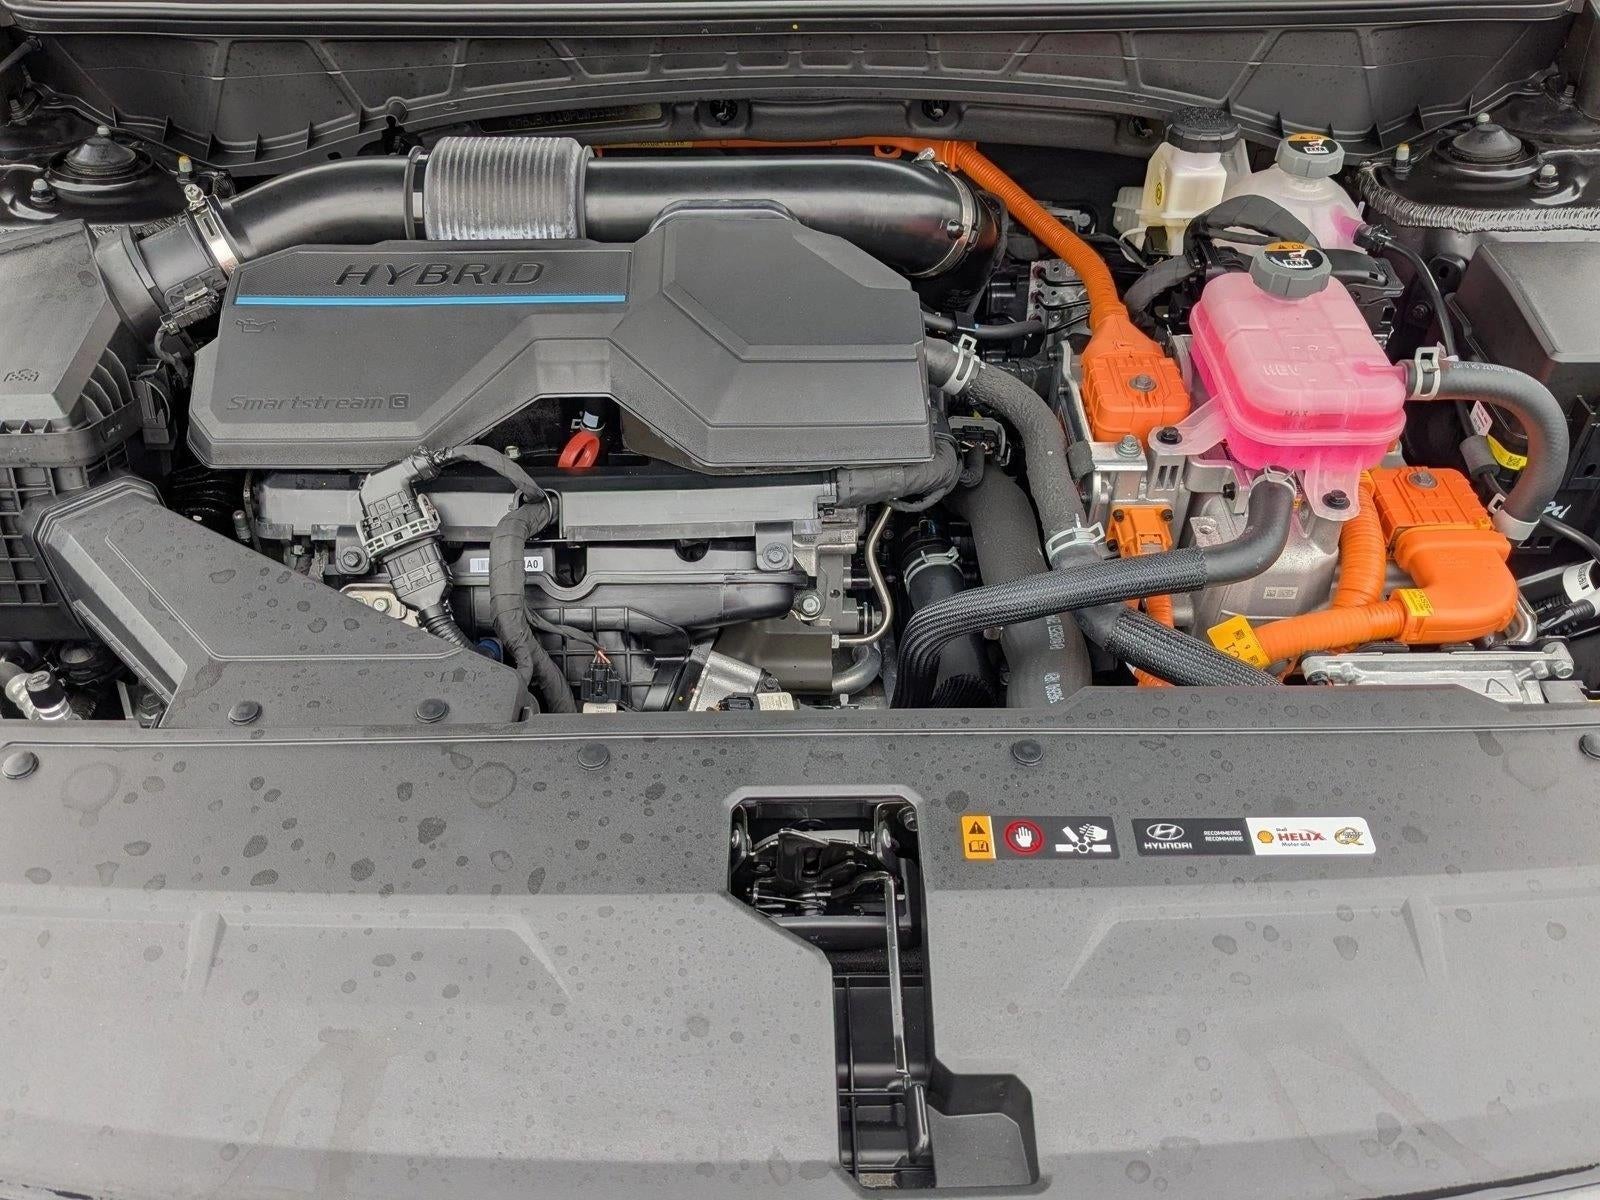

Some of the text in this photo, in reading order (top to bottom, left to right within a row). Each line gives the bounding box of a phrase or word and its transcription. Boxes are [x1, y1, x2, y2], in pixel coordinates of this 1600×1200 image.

[334, 262, 546, 287] HYBRID
[226, 394, 385, 411] Smartstream
[526, 559, 539, 569] A0
[1278, 832, 1325, 841] HELIX
[1144, 842, 1193, 850] HYUNDAI
